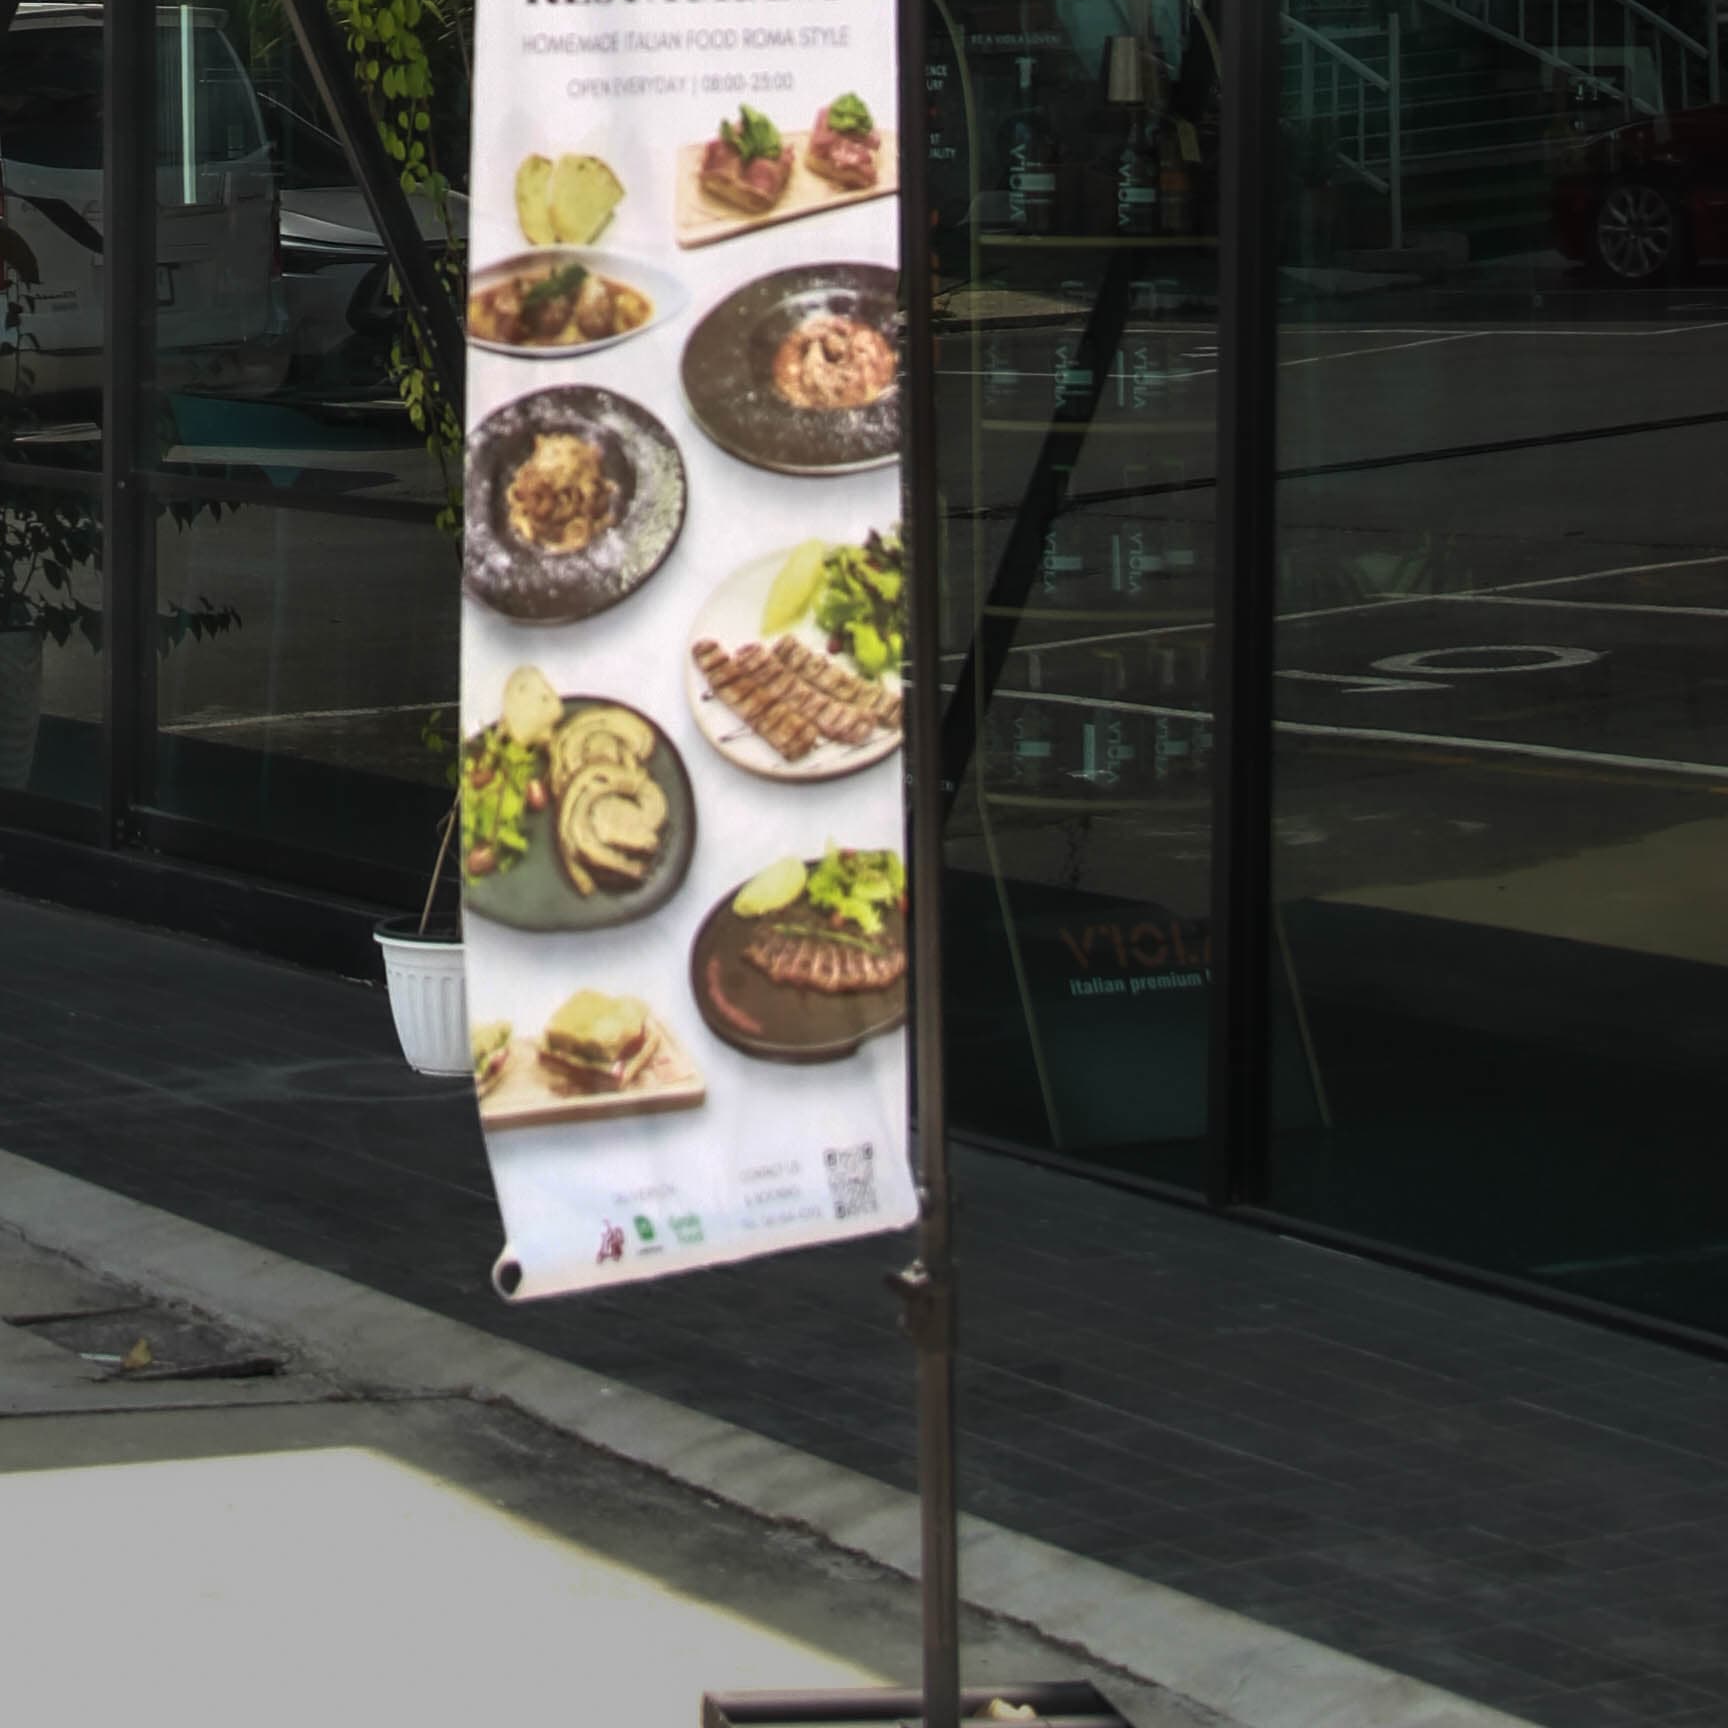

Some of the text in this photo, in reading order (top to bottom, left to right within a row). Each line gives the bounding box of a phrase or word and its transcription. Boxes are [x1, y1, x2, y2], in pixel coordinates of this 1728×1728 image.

[522, 23, 851, 55] HOMEMADE ITALIAN FOOD ROMA STYLE
[1068, 976, 1125, 997] italian
[1128, 971, 1203, 995] premium
